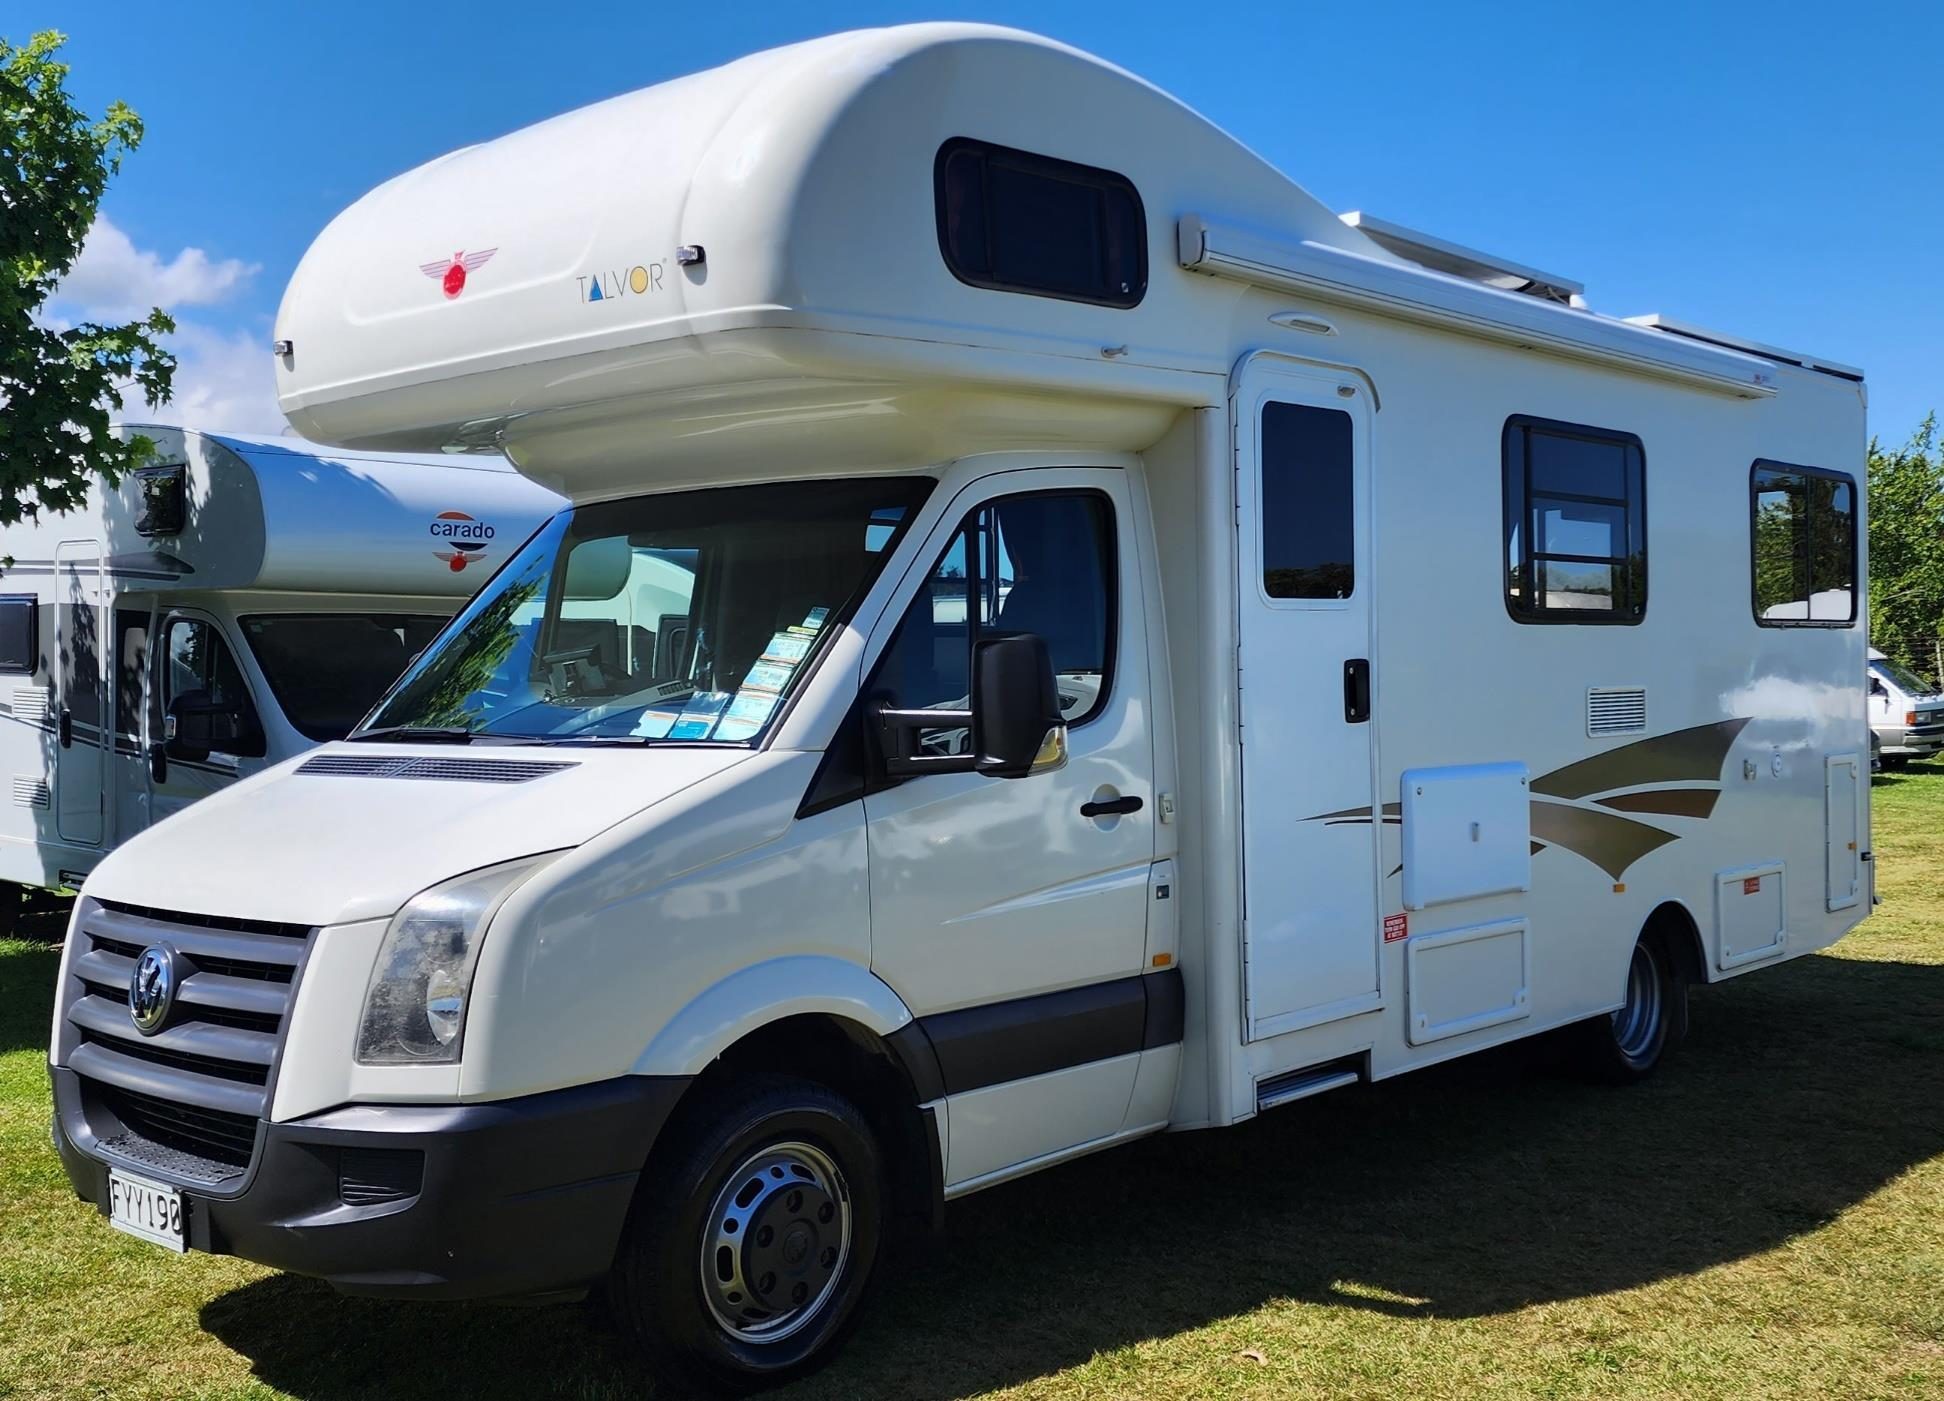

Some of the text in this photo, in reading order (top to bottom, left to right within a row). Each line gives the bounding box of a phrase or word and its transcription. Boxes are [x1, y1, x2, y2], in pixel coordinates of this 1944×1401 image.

[576, 263, 664, 305] TALVOR
[430, 522, 495, 538] carado
[110, 1178, 182, 1236] FYY190
